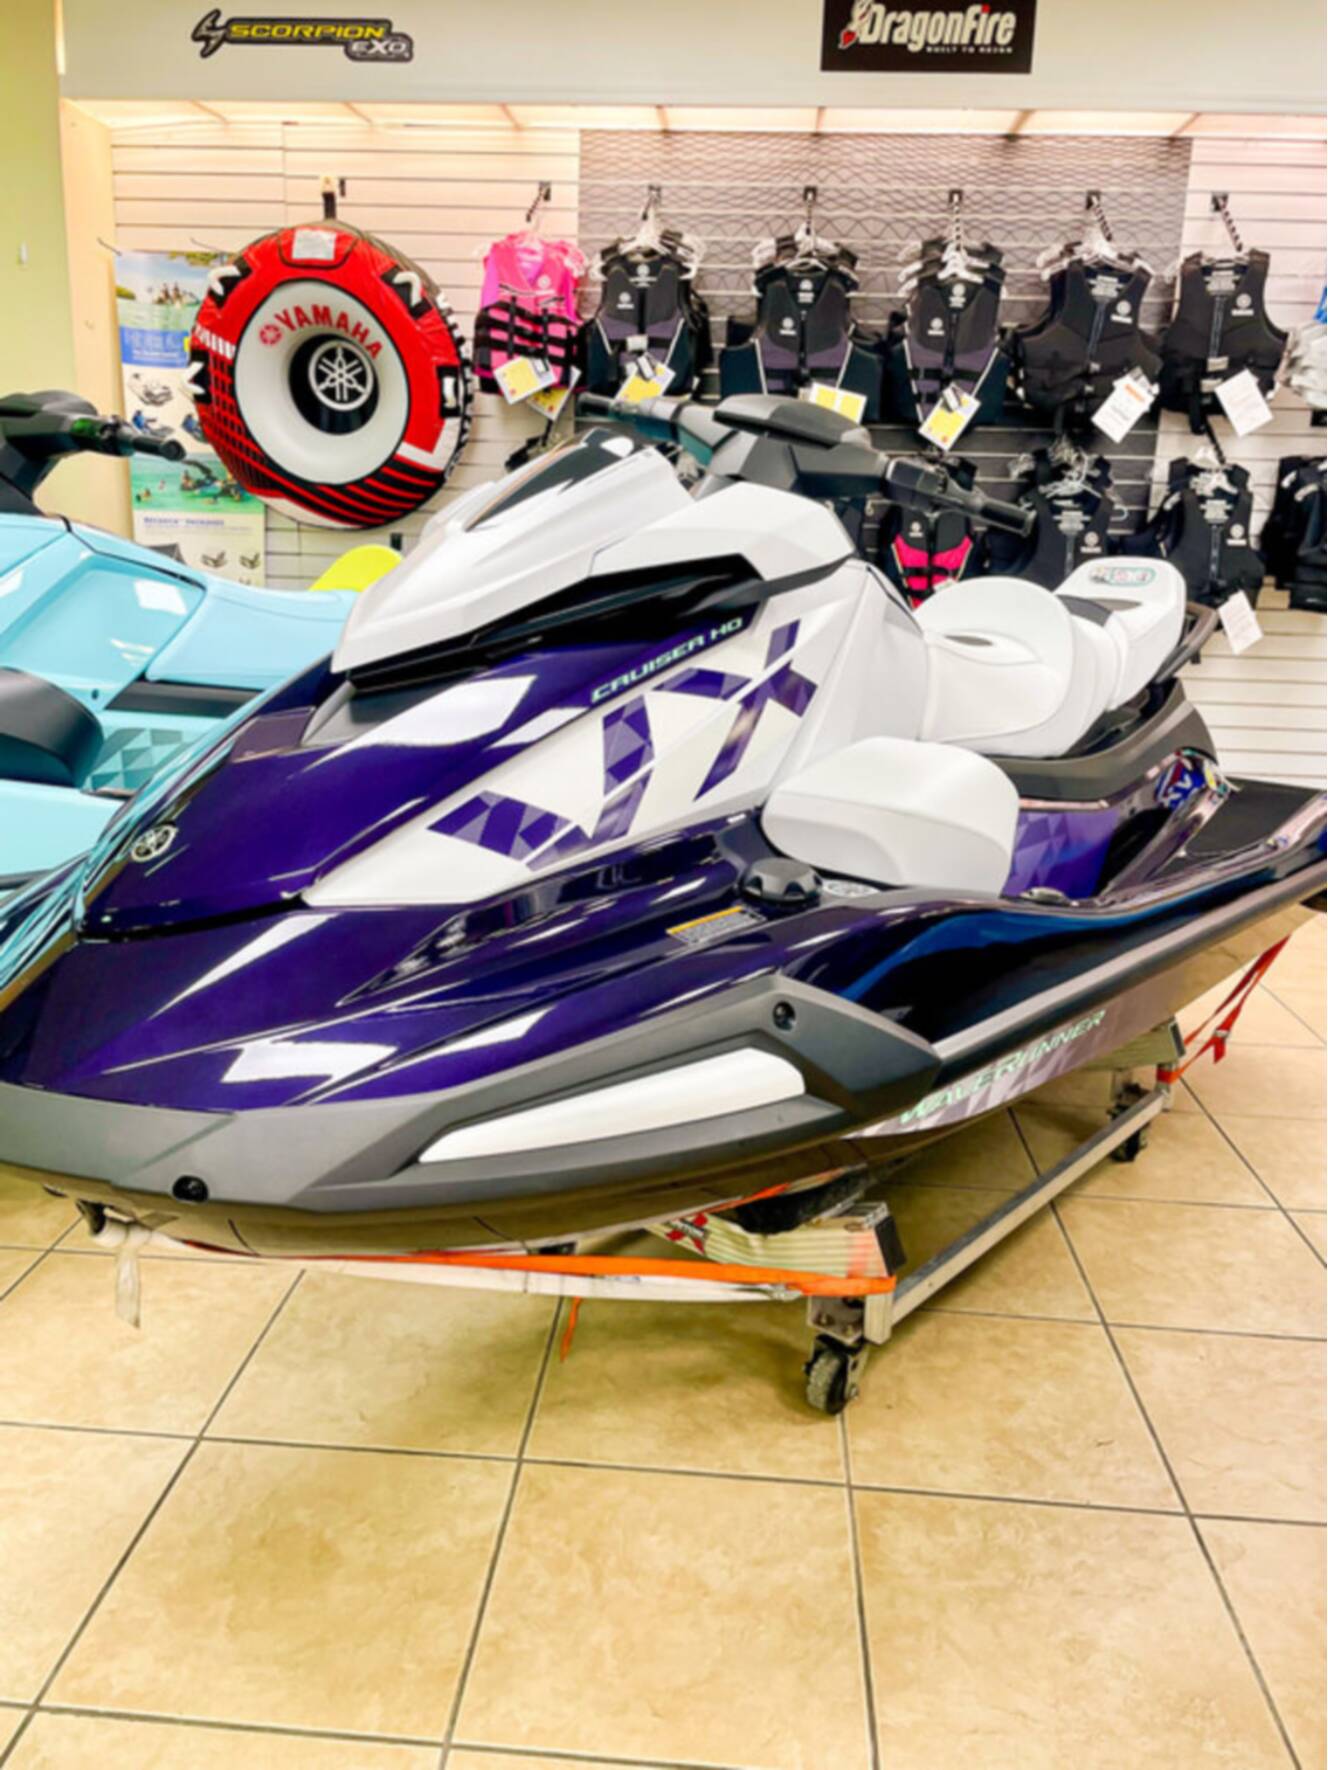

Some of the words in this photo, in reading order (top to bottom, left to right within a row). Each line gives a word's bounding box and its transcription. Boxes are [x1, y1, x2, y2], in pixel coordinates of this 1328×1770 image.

[230, 24, 385, 38] SCORPION
[352, 39, 406, 54] EXO
[857, 3, 1016, 52] DragonFire
[274, 304, 382, 359] YAMAHA
[592, 635, 704, 702] CRUISER
[711, 617, 743, 640] HO
